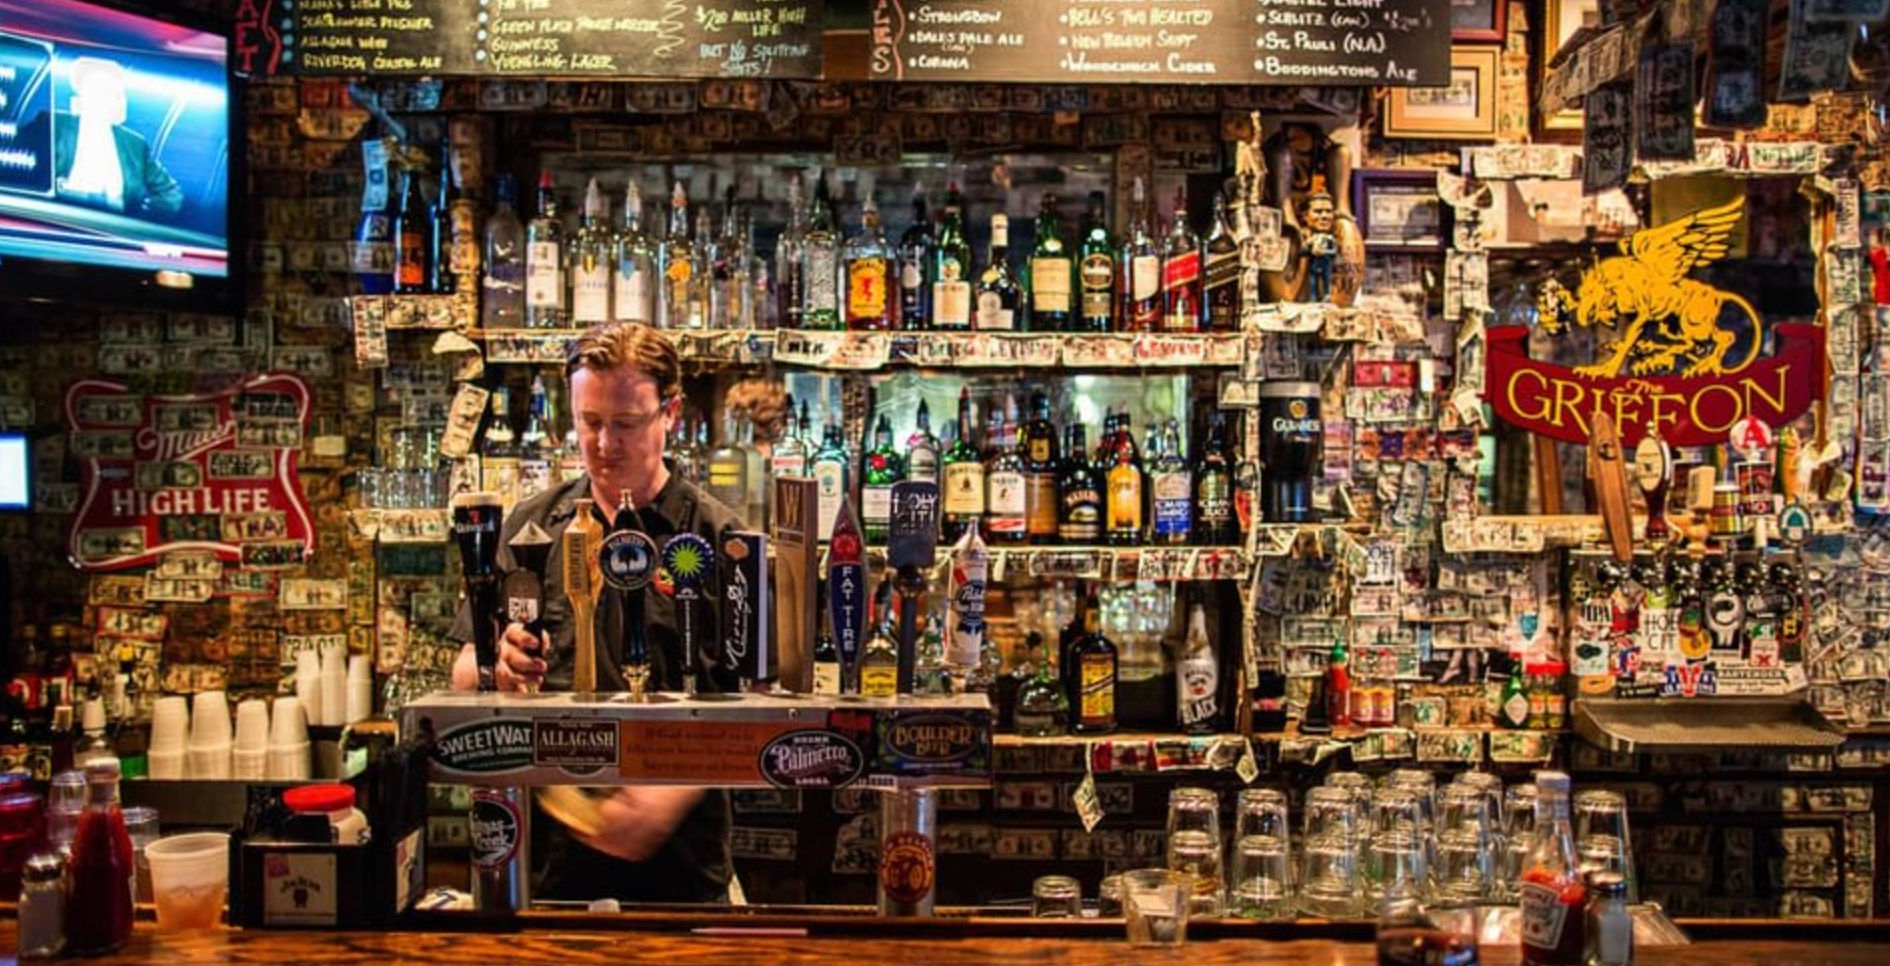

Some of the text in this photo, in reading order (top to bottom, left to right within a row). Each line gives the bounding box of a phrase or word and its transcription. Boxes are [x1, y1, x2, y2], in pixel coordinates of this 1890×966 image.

[918, 6, 1001, 24] STRONGBOW
[959, 33, 993, 45] PALE
[999, 34, 1024, 45] ALE
[1294, 31, 1336, 51] PAULI
[1266, 56, 1419, 81] BODDINGTONS ALE
[1508, 364, 1790, 438] GRIFFON
[111, 488, 271, 517] HIGH LIFE
[841, 566, 854, 651] FAT TIRE
[437, 724, 531, 758] SWEETWAT
[539, 730, 614, 747] ALLAGASH
[895, 727, 972, 745] BOULDER
